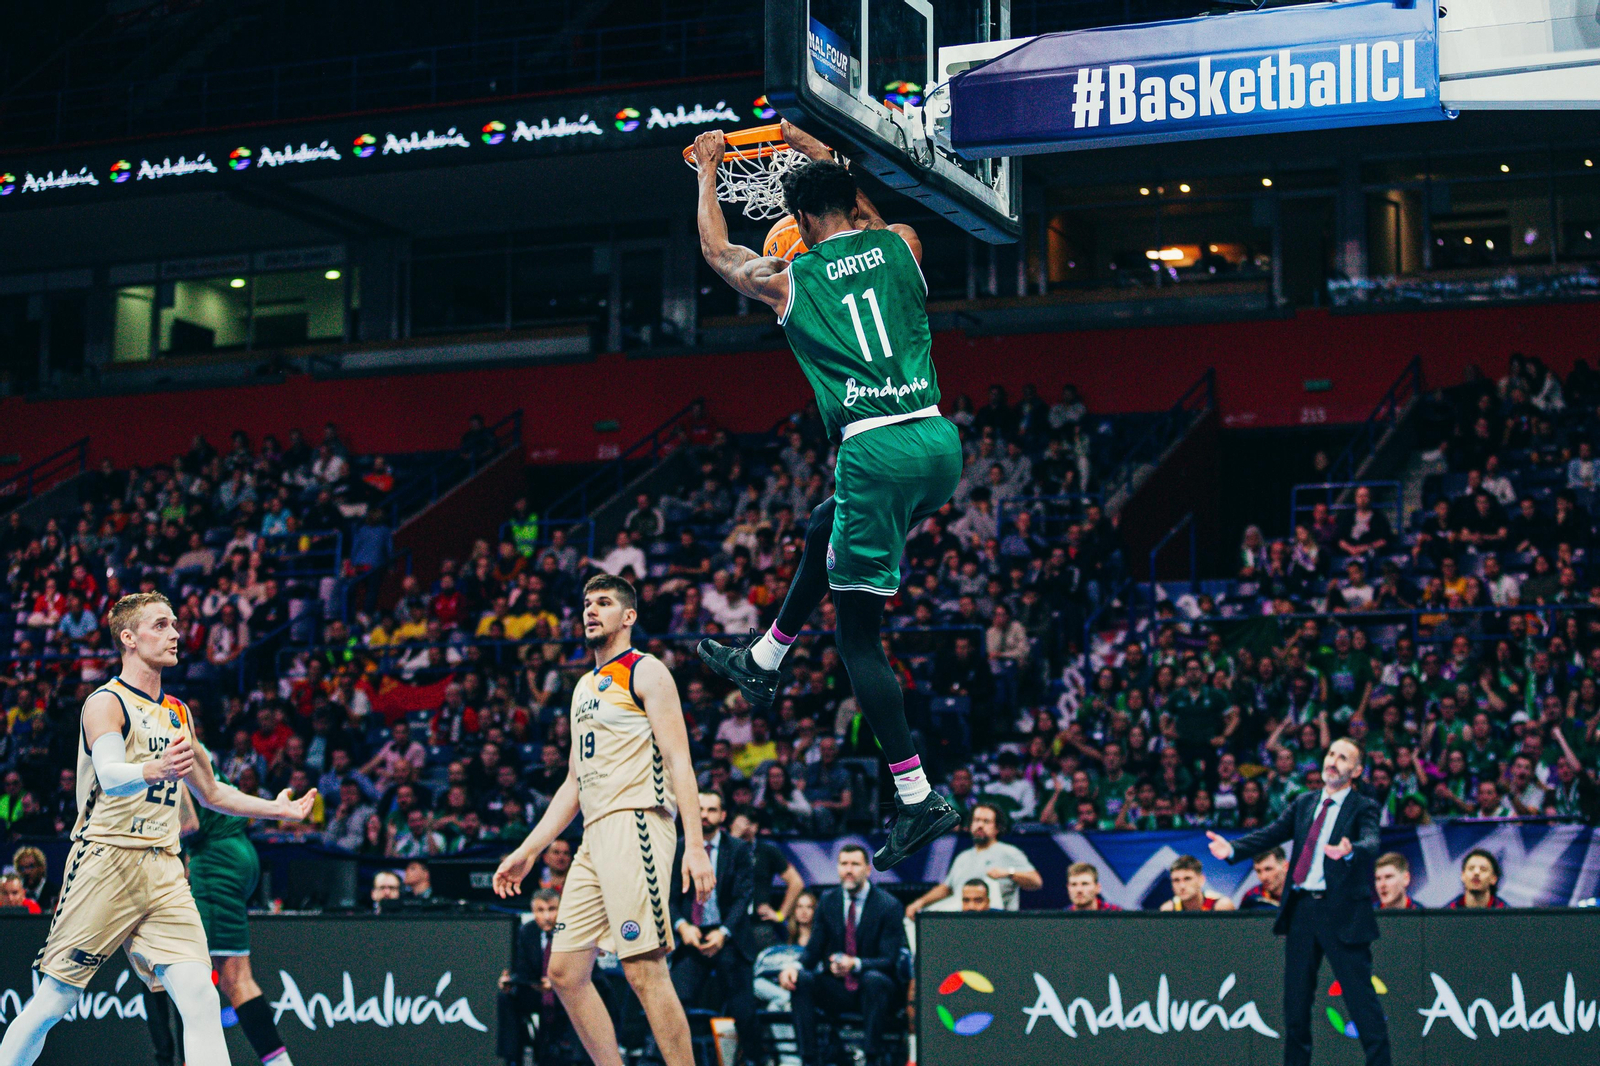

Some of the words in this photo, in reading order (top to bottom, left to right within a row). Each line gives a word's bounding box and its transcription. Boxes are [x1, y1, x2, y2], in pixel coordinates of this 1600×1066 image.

[809, 31, 826, 57] NAL
[826, 43, 848, 72] FOUR
[1071, 39, 1426, 128] #BasketballCL
[826, 247, 886, 281] CARTER
[841, 287, 893, 362] 11
[575, 699, 600, 717] UCAM
[580, 731, 595, 761] 19
[145, 779, 178, 807] 22
[271, 970, 487, 1032] Andalucía
[1023, 972, 1279, 1038] Andalucía
[1418, 972, 1600, 1040] Andalu
